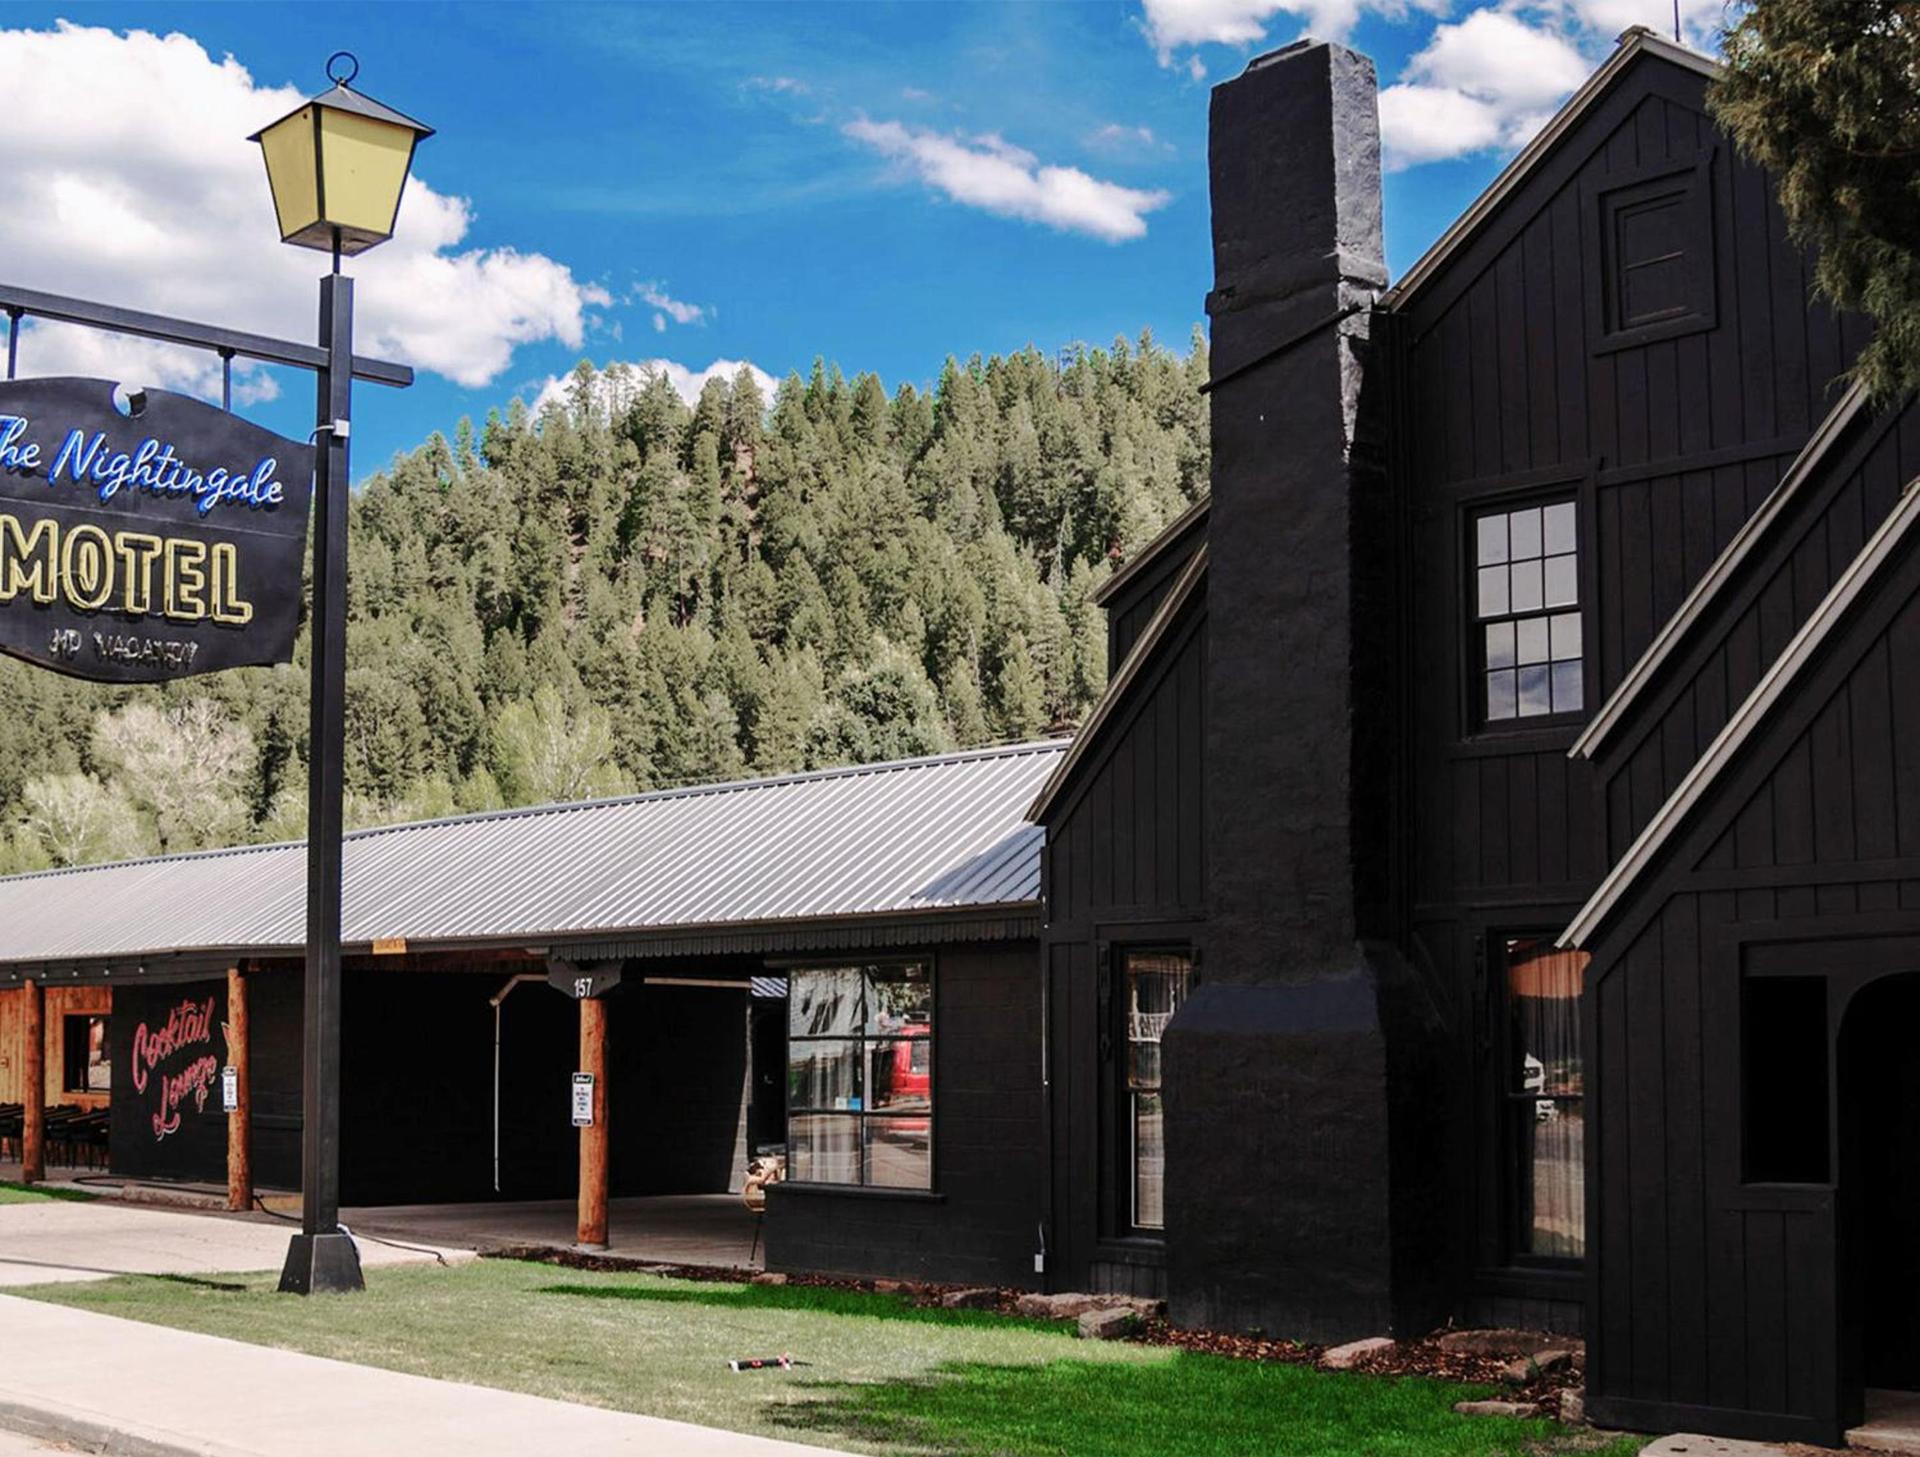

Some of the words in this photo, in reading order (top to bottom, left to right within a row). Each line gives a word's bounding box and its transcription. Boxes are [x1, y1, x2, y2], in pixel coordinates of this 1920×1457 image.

[49, 428, 284, 513] Nightingale
[0, 514, 253, 624] MOTEL
[132, 997, 215, 1094] Cocktail
[152, 1055, 217, 1142] Lounge
